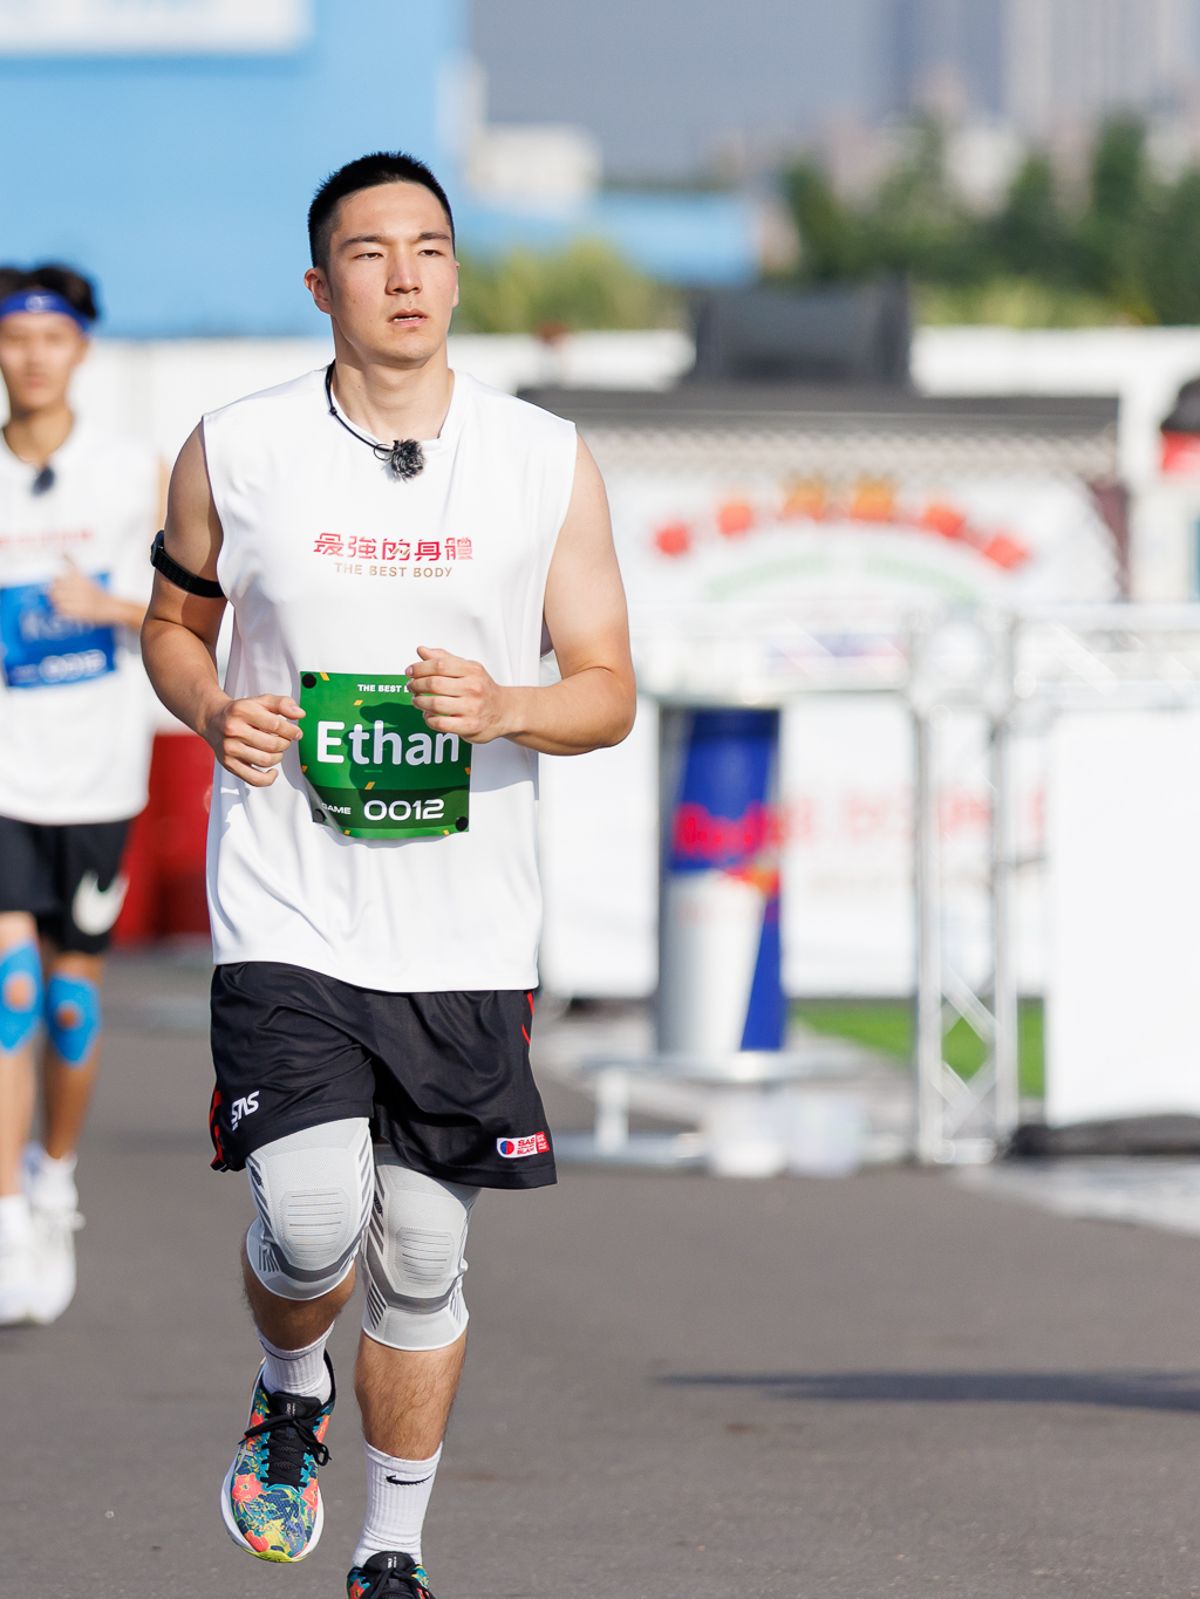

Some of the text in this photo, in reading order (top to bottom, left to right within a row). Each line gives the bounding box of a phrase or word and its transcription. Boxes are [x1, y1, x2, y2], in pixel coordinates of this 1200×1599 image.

[335, 562, 453, 578] THE BEST BODY
[357, 683, 376, 693] THE
[378, 684, 402, 693] BEST
[316, 719, 460, 766] Ethan
[363, 798, 445, 821] 0012
